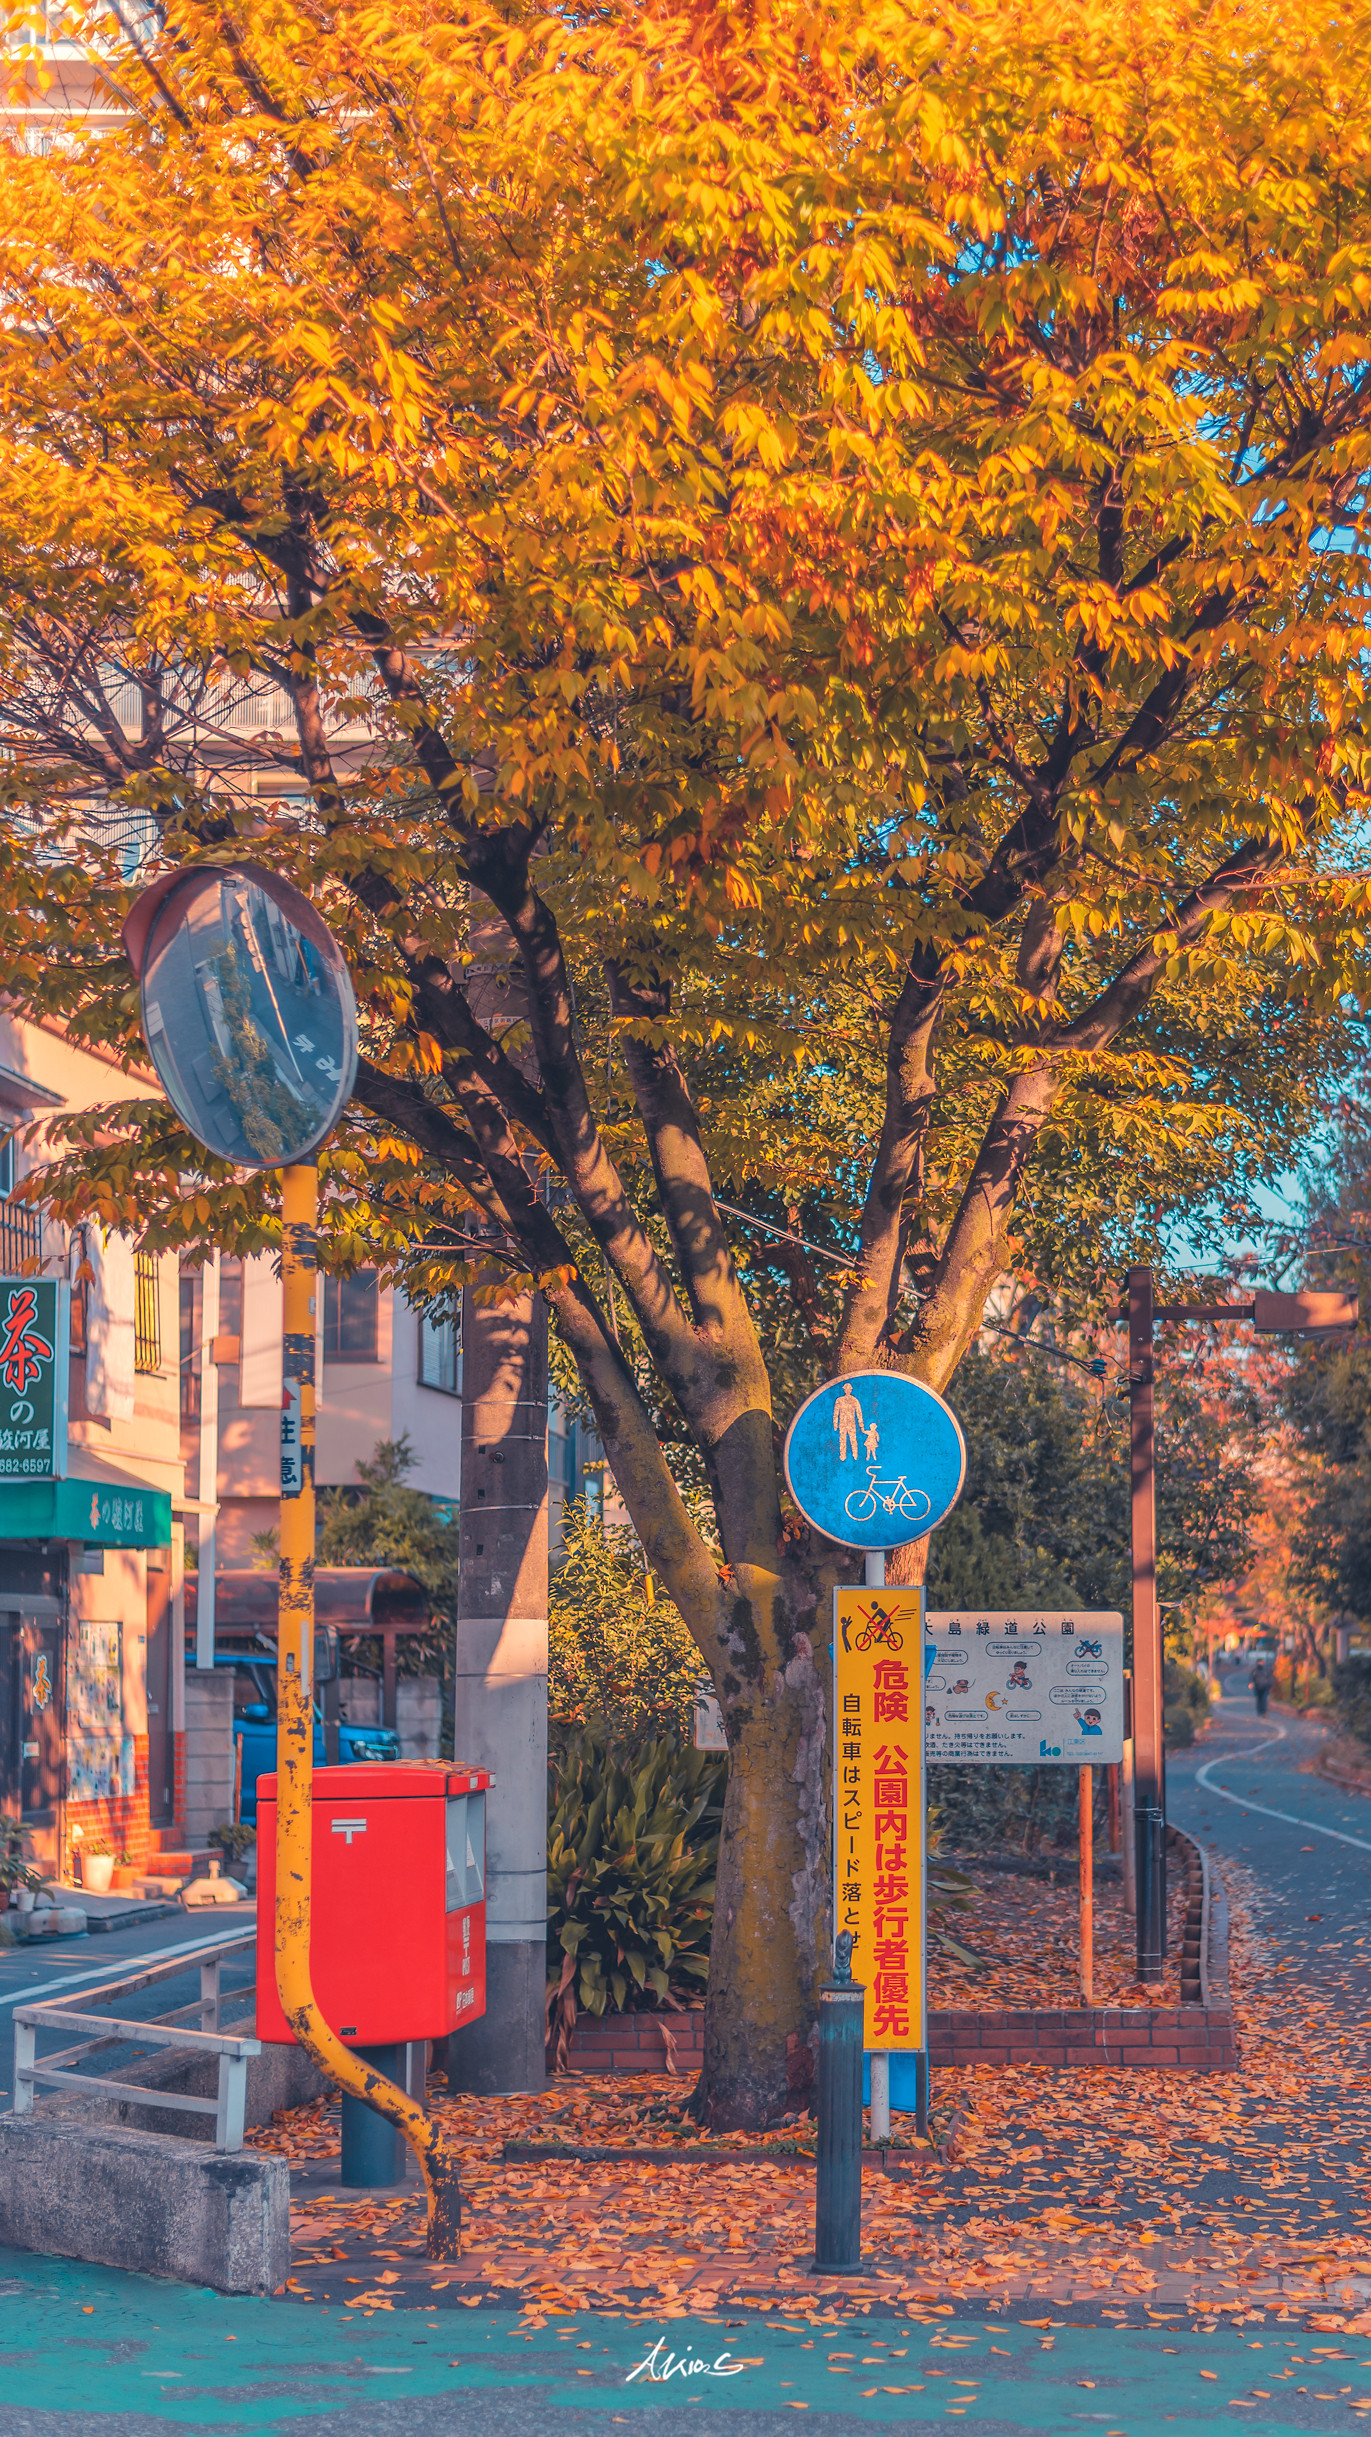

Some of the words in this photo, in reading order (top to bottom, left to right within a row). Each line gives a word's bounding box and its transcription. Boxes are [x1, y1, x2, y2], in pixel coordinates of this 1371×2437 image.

[873, 1659, 909, 1723] 危険
[873, 1744, 909, 2037] 公園内は歩行者優先
